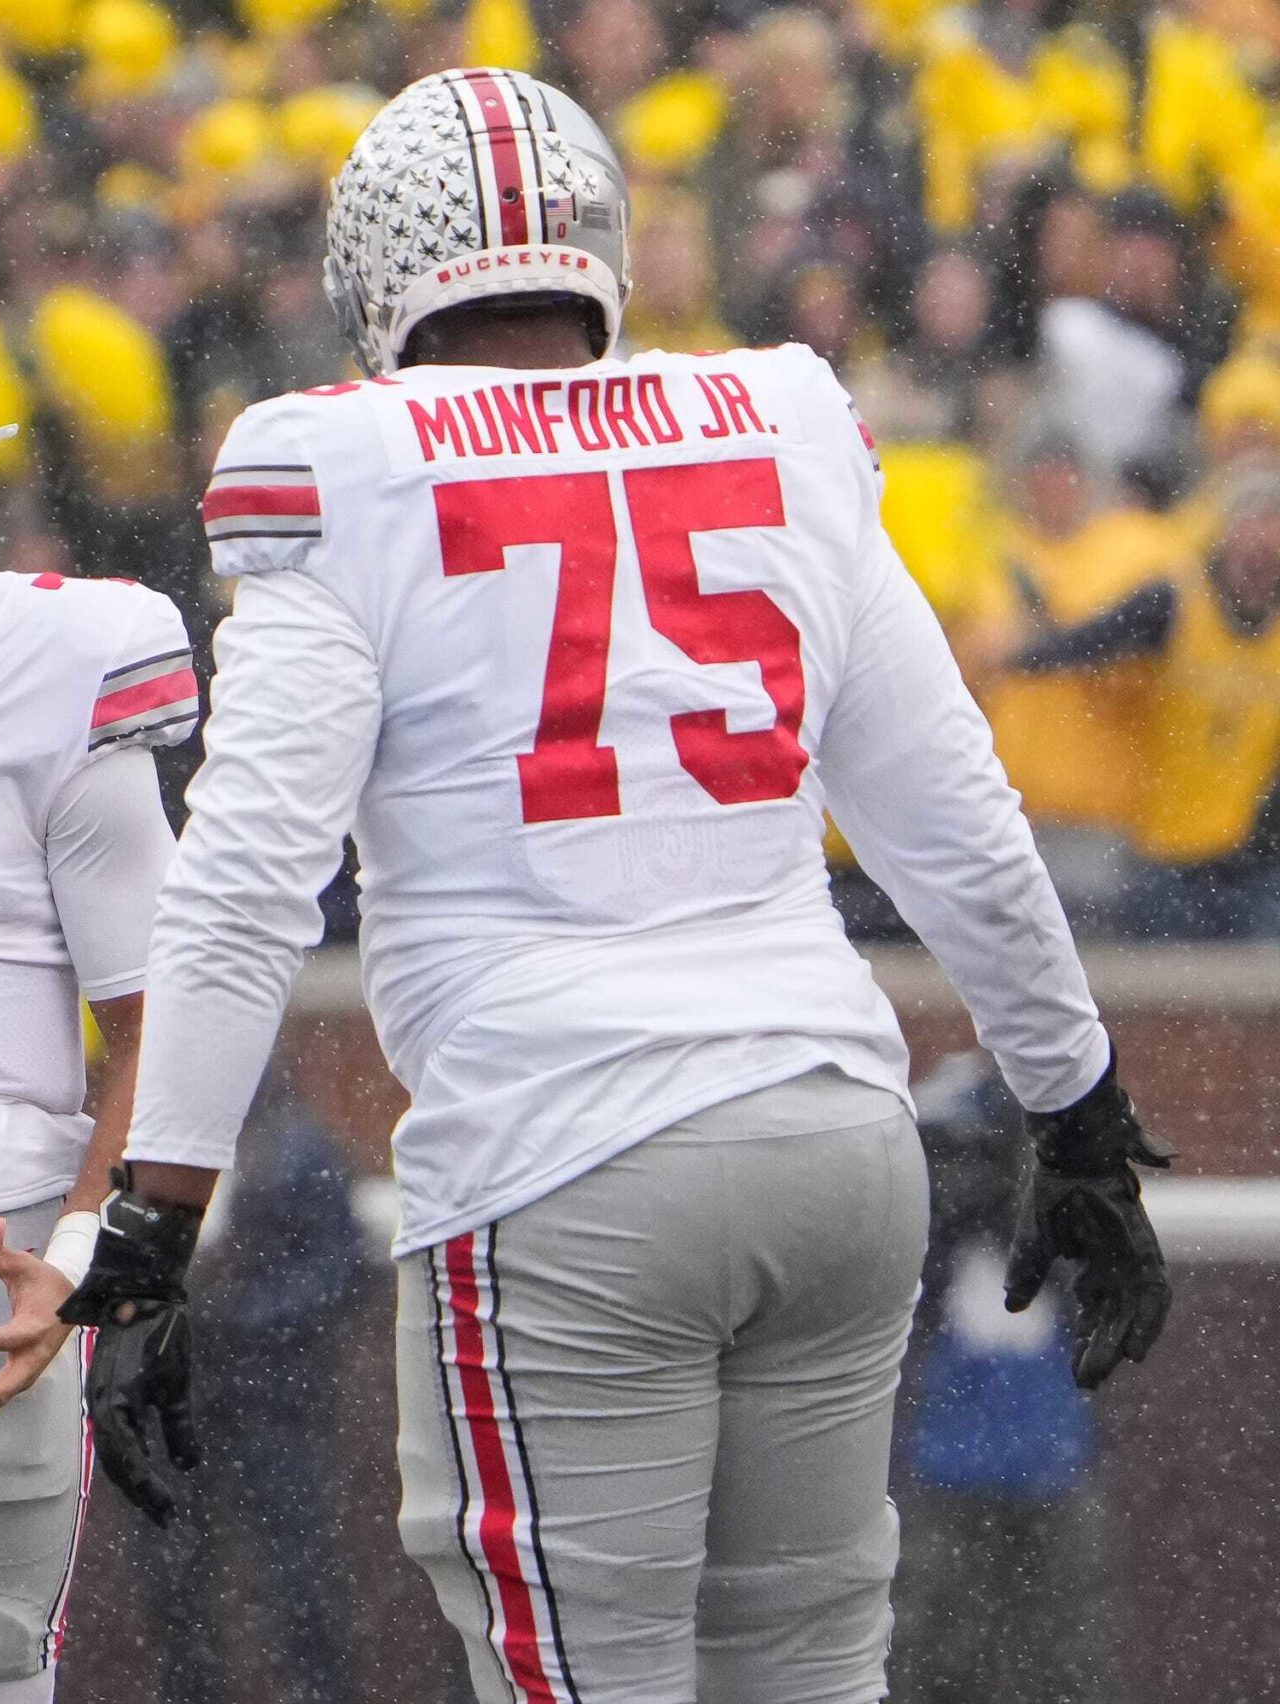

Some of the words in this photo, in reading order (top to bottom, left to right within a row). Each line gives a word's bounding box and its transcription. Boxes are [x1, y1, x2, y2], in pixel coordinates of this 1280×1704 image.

[437, 252, 589, 284] BUCKEYES
[406, 374, 684, 462] MUNFORD
[693, 373, 778, 438] JR.
[433, 457, 810, 824] 75
